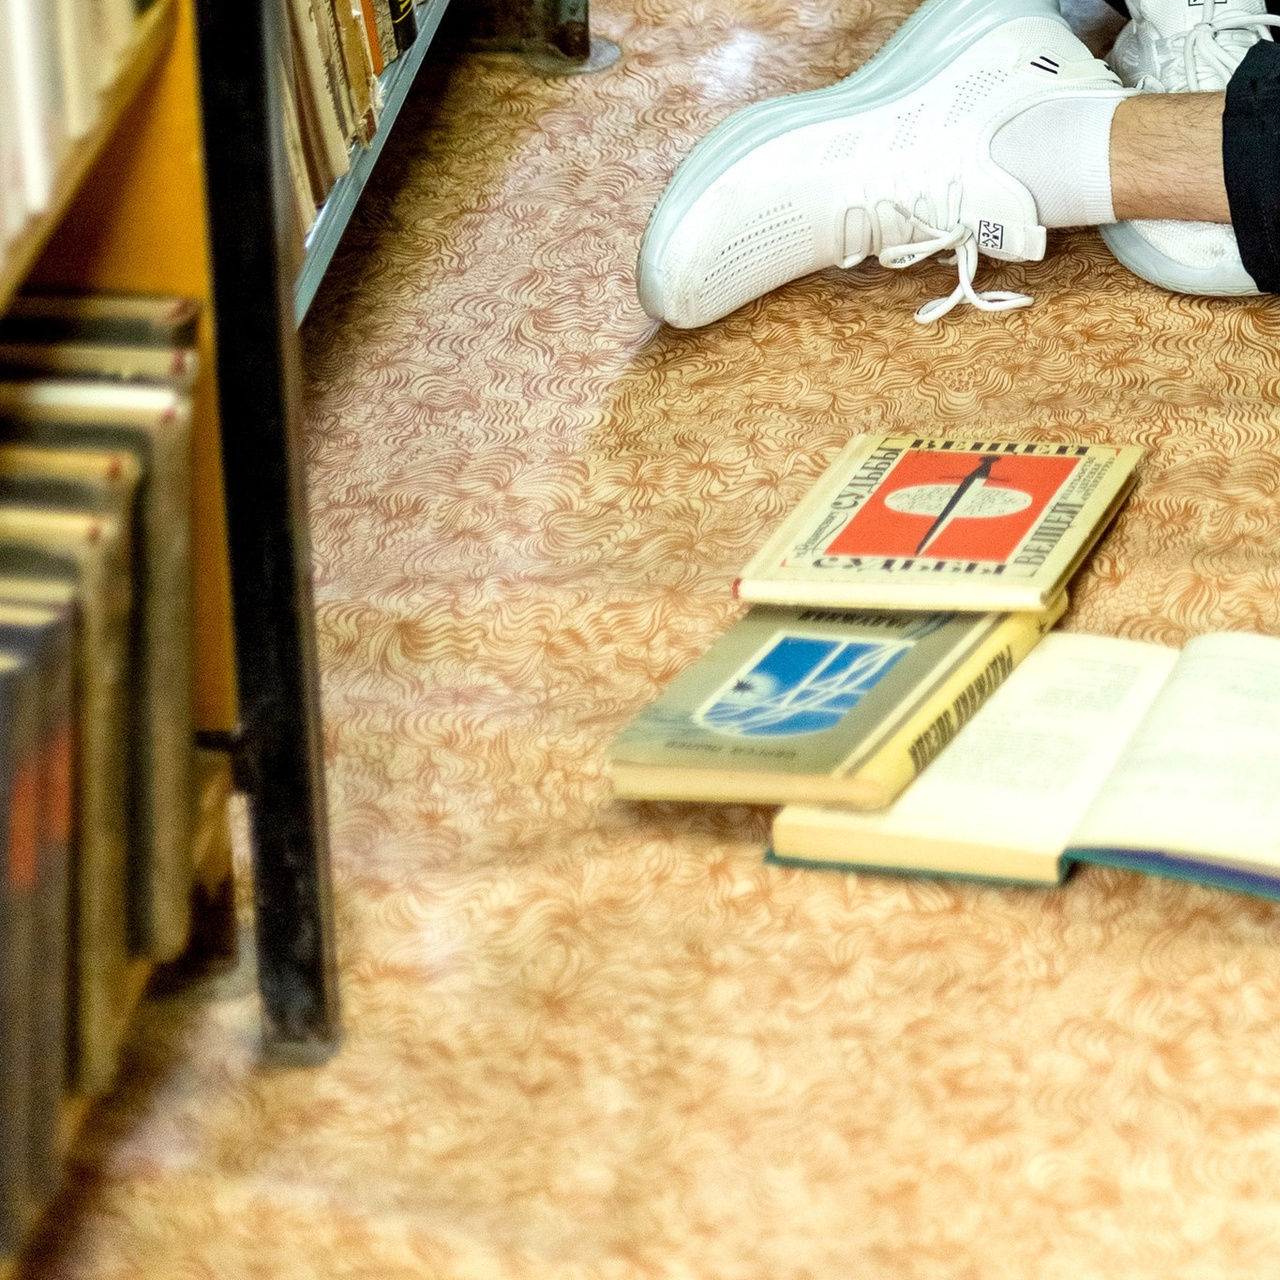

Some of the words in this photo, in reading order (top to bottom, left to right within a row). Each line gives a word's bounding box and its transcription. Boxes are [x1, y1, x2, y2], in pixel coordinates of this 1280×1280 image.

[910, 439, 1090, 456] ВЕЩЕЙ
[830, 437, 903, 511] СУДЬБЫ
[1013, 502, 1084, 570] ВЕЩЕЙ
[812, 556, 1007, 574] СУДЬБЫ
